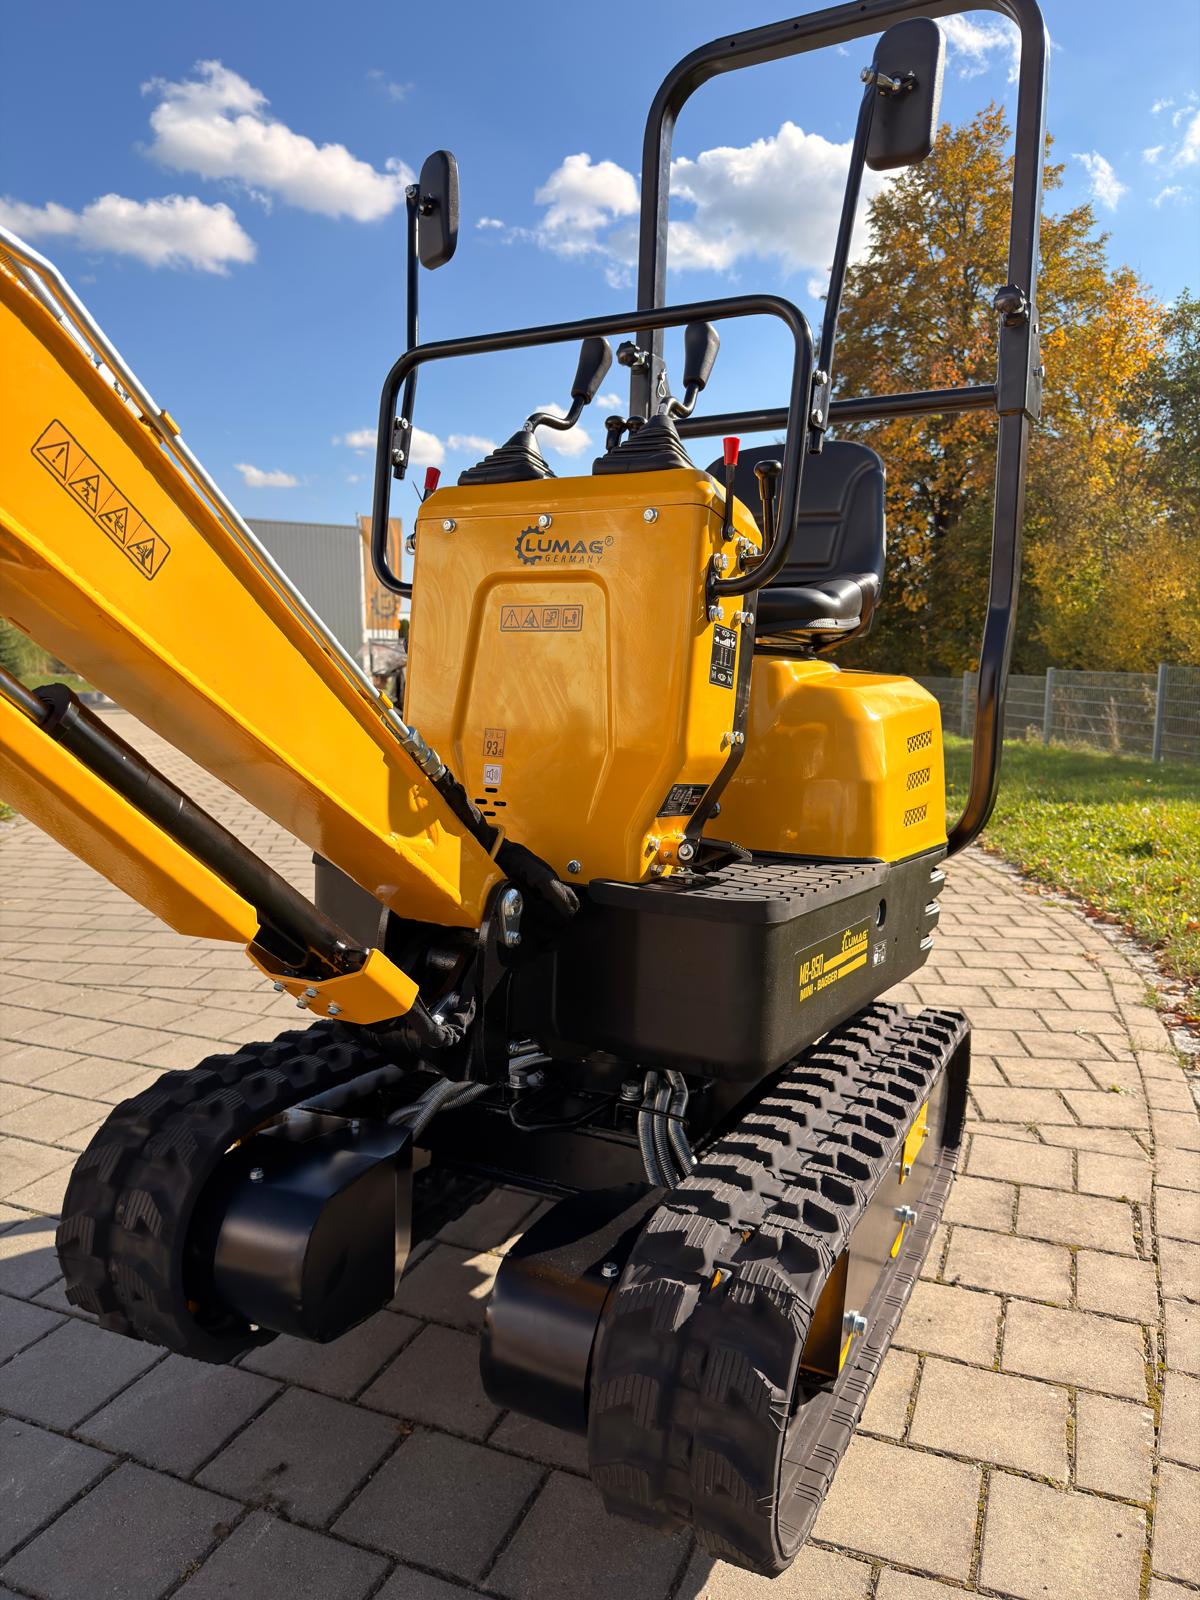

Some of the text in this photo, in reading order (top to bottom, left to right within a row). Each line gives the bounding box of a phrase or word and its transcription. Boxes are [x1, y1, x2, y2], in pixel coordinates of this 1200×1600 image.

[545, 555, 602, 564] GERMANY
[486, 740, 498, 756] 93
[800, 953, 824, 986] MB-850
[800, 983, 814, 1002] MINI
[817, 970, 838, 991] BAGGER
